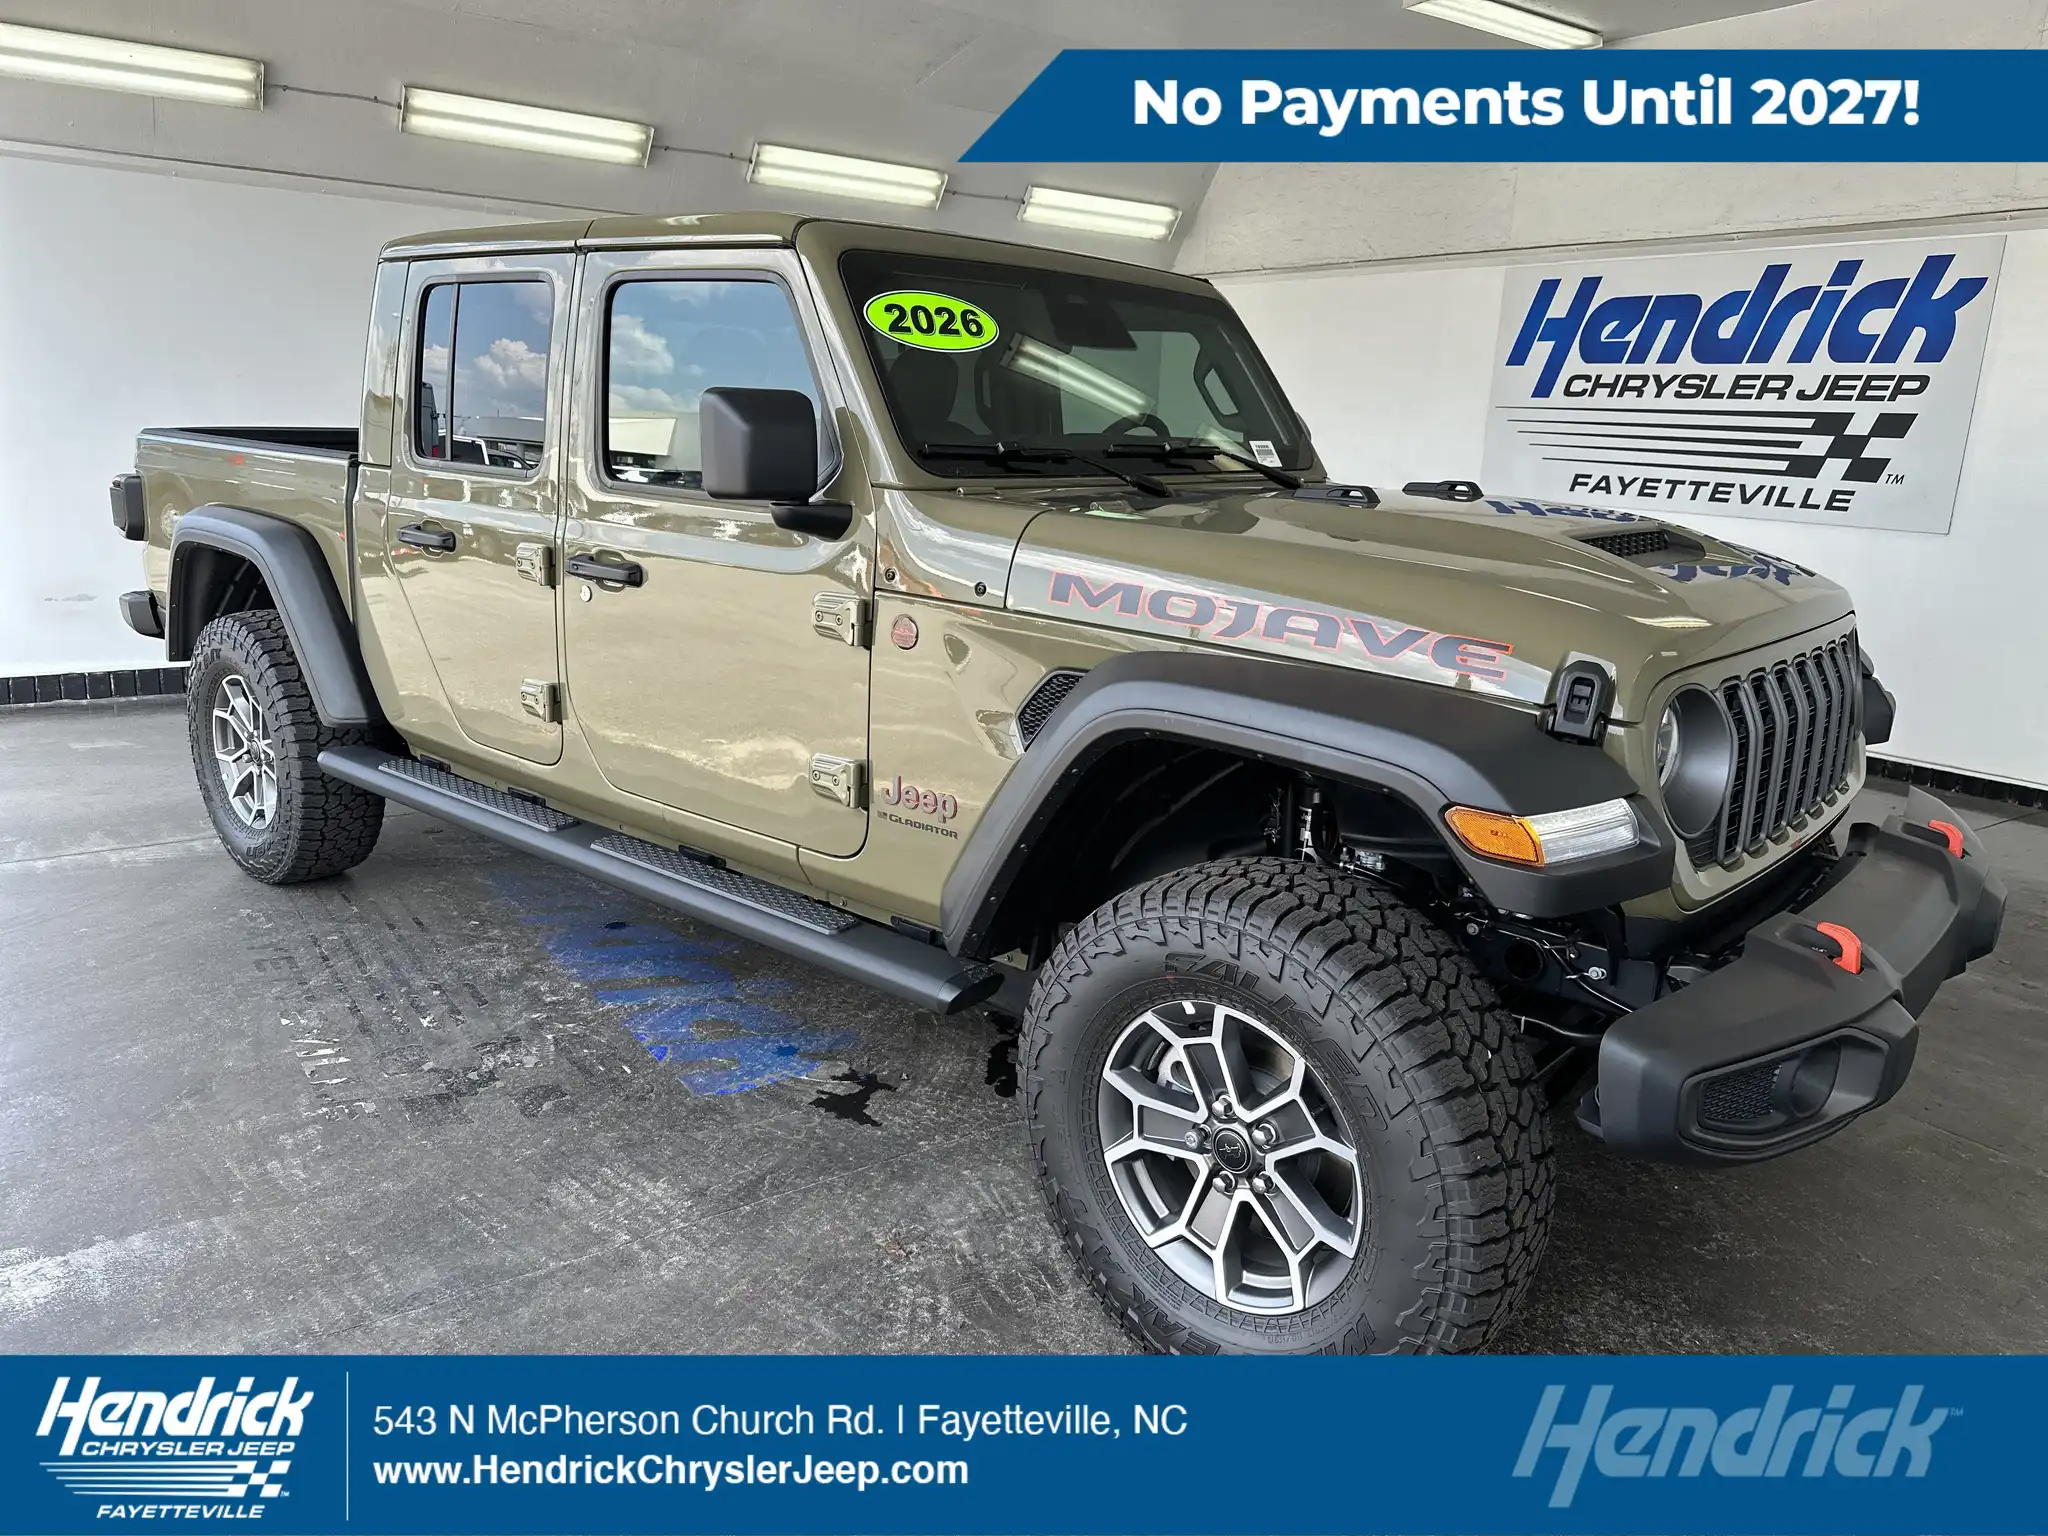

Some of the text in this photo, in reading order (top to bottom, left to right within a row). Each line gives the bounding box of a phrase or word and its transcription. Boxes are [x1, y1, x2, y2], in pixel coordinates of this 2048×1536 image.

[884, 303, 985, 338] 2026
[1505, 254, 1989, 398] Hendrick
[1563, 374, 1930, 402] CHRYSLER JEEP
[1569, 473, 1855, 512] FAYETTEVILLE
[1885, 474, 1905, 484] TM
[1049, 571, 1514, 681] MOJAVE
[881, 775, 958, 823] Jeep
[889, 813, 958, 840] GLADIATOR
